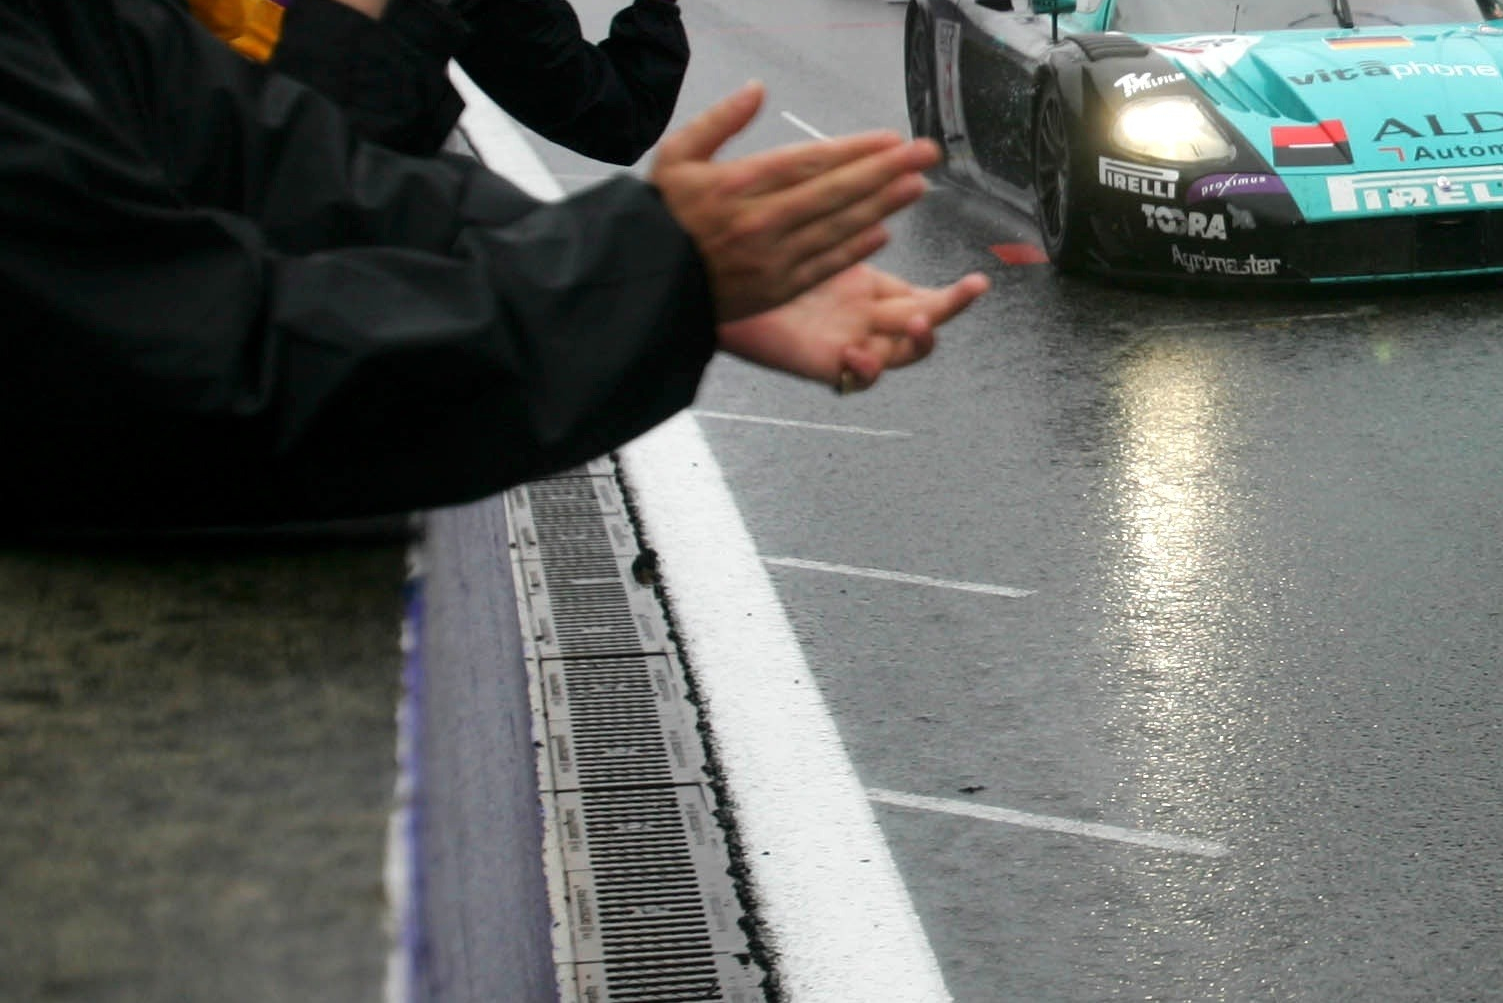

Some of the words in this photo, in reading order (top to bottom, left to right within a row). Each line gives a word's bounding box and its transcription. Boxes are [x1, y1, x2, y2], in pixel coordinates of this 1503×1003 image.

[1288, 59, 1500, 86] vitaphone
[1099, 155, 1180, 200] PIRELLI
[1201, 172, 1267, 198] proximus
[1171, 243, 1281, 275] Agrimaster
